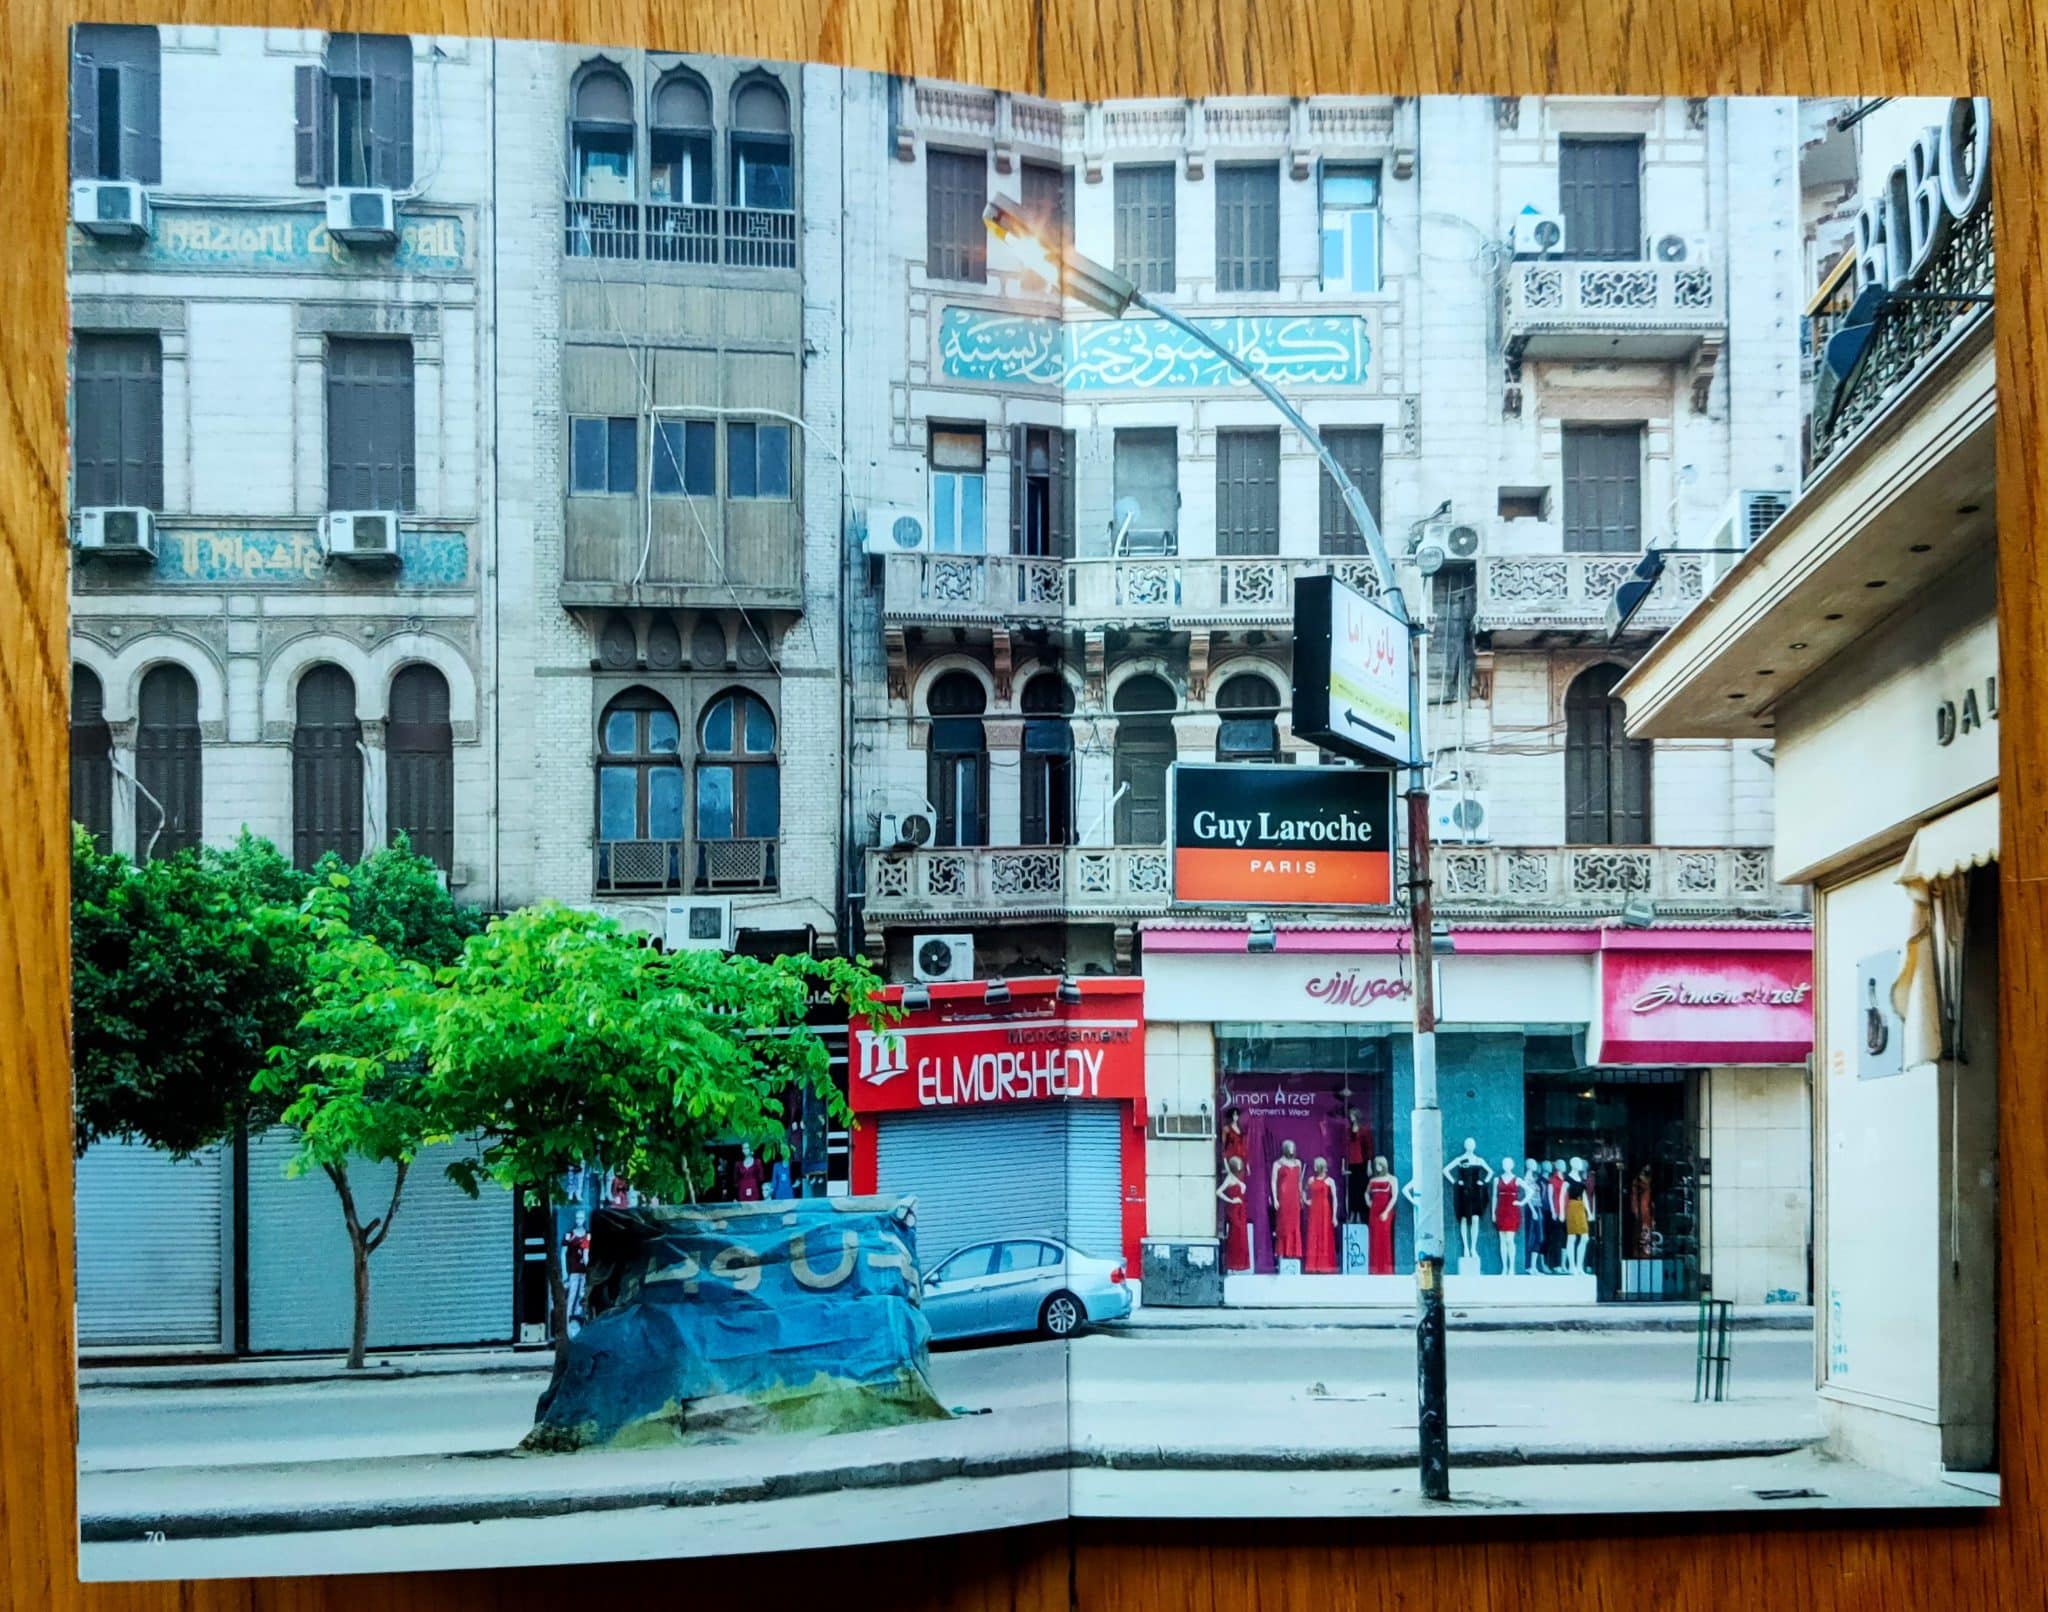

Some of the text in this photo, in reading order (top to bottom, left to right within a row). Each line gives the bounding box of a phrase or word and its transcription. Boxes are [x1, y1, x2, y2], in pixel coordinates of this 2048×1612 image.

[1192, 810, 1373, 846] Guy Laroche
[1250, 859, 1317, 874] PARIS
[1631, 982, 1743, 1013] Simon
[1220, 1081, 1317, 1111] Simon Arzet
[1248, 1106, 1311, 1117] Women's Wear
[144, 1530, 166, 1545] 70
